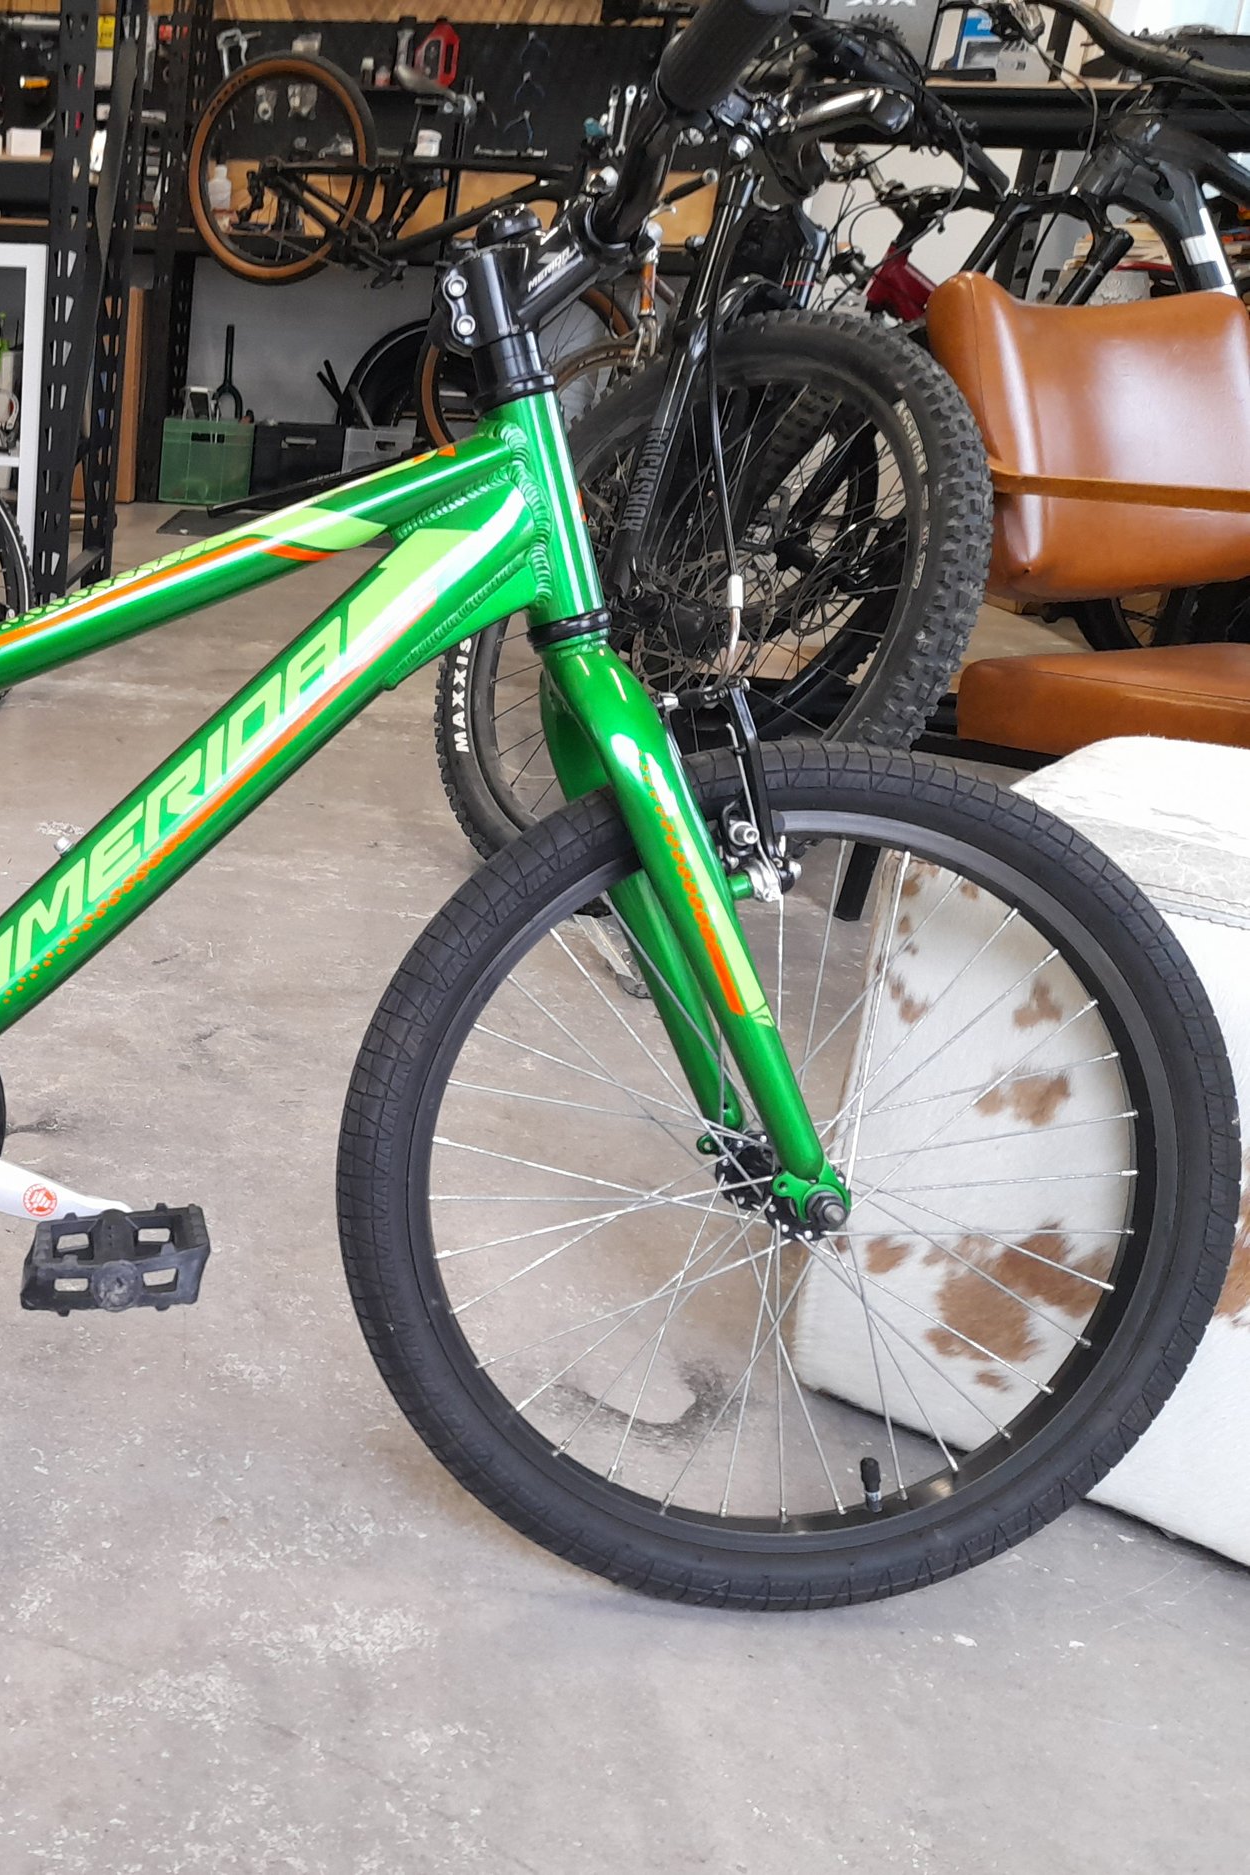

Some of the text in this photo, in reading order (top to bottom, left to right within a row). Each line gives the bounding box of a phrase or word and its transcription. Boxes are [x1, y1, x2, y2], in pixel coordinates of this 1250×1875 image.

[619, 429, 670, 531] ROCKSHOX
[452, 638, 472, 753] MAXXIS
[15, 615, 342, 975] MERIDA
